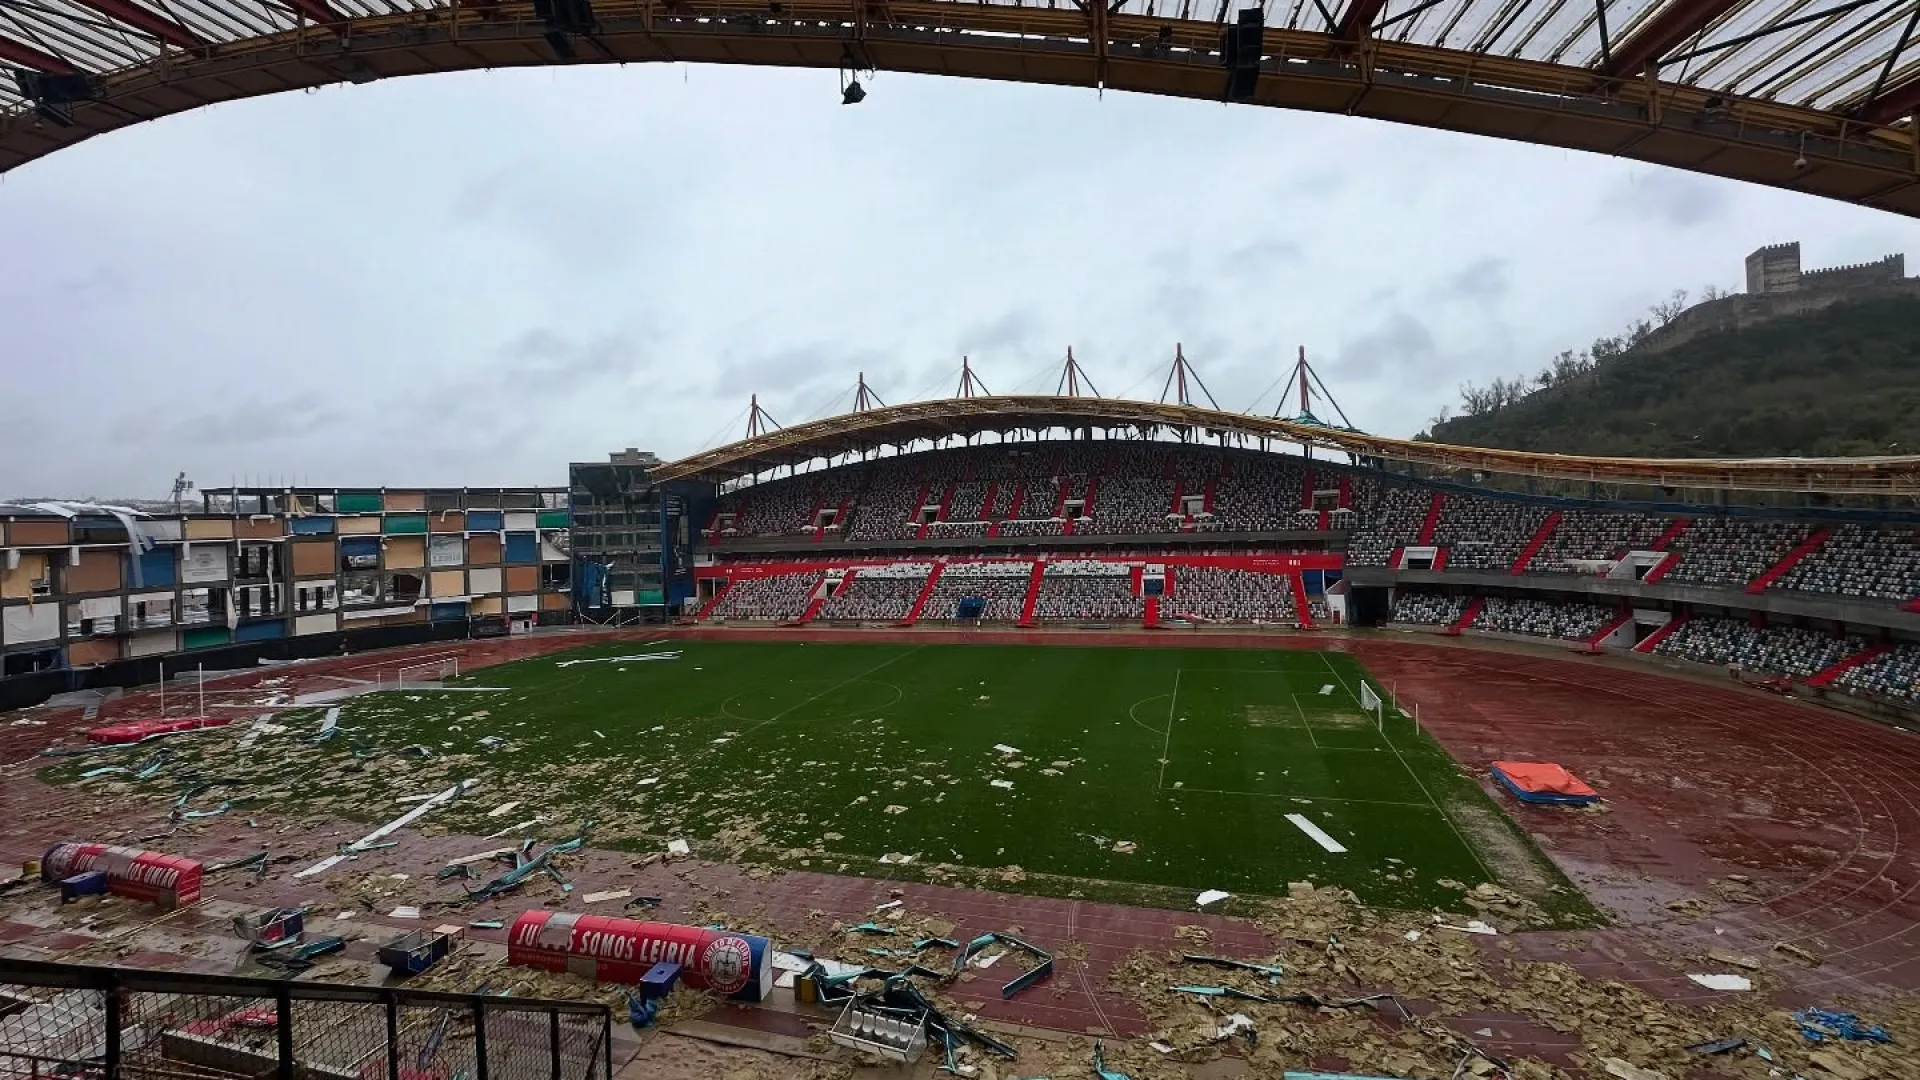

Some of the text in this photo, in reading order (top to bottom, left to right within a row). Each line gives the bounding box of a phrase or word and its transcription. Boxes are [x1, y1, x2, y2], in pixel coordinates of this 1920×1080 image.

[144, 866, 180, 889] UNIÃO
[580, 930, 636, 959] SOMOS
[640, 939, 697, 969] LEIRIA
